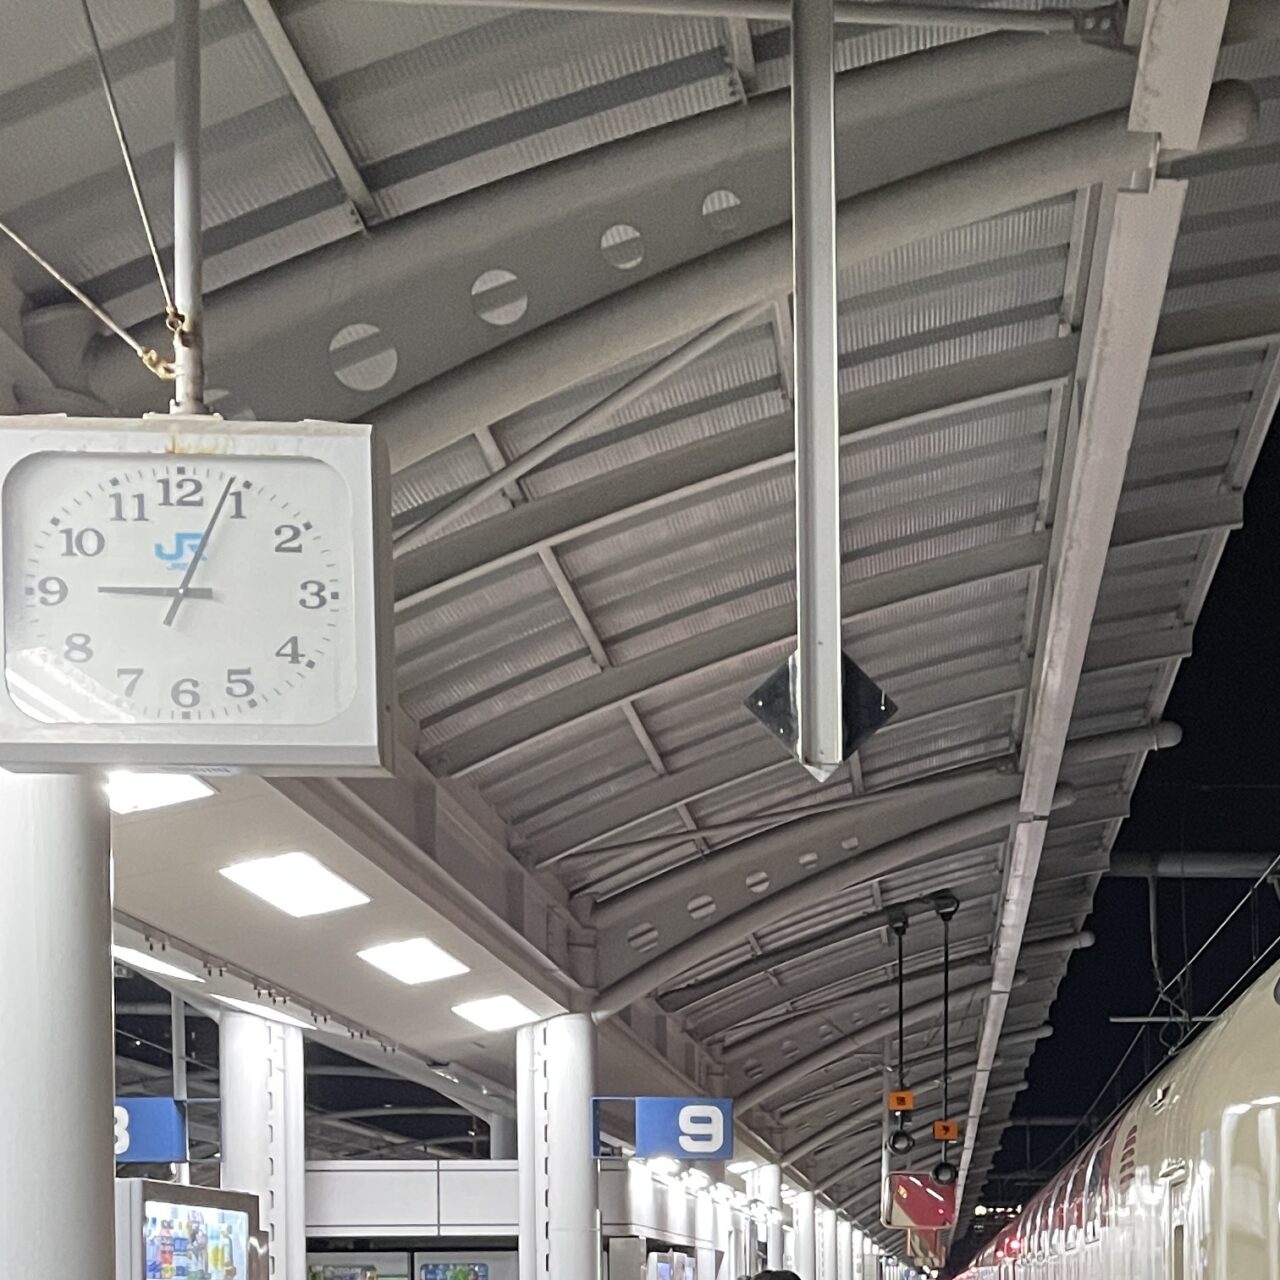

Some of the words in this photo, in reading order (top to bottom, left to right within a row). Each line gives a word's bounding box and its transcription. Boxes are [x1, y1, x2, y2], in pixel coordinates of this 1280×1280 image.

[157, 478, 204, 507] 12
[229, 490, 247, 519] 1
[110, 493, 149, 522] 11
[60, 528, 105, 557] 10
[274, 524, 303, 554] 2
[38, 576, 69, 606] 9
[299, 580, 327, 609] 3
[63, 633, 94, 663] 8
[275, 636, 306, 664] 4
[117, 668, 144, 697] 7
[170, 679, 200, 708] 6
[226, 667, 255, 698] 5
[679, 1105, 724, 1153] 9
